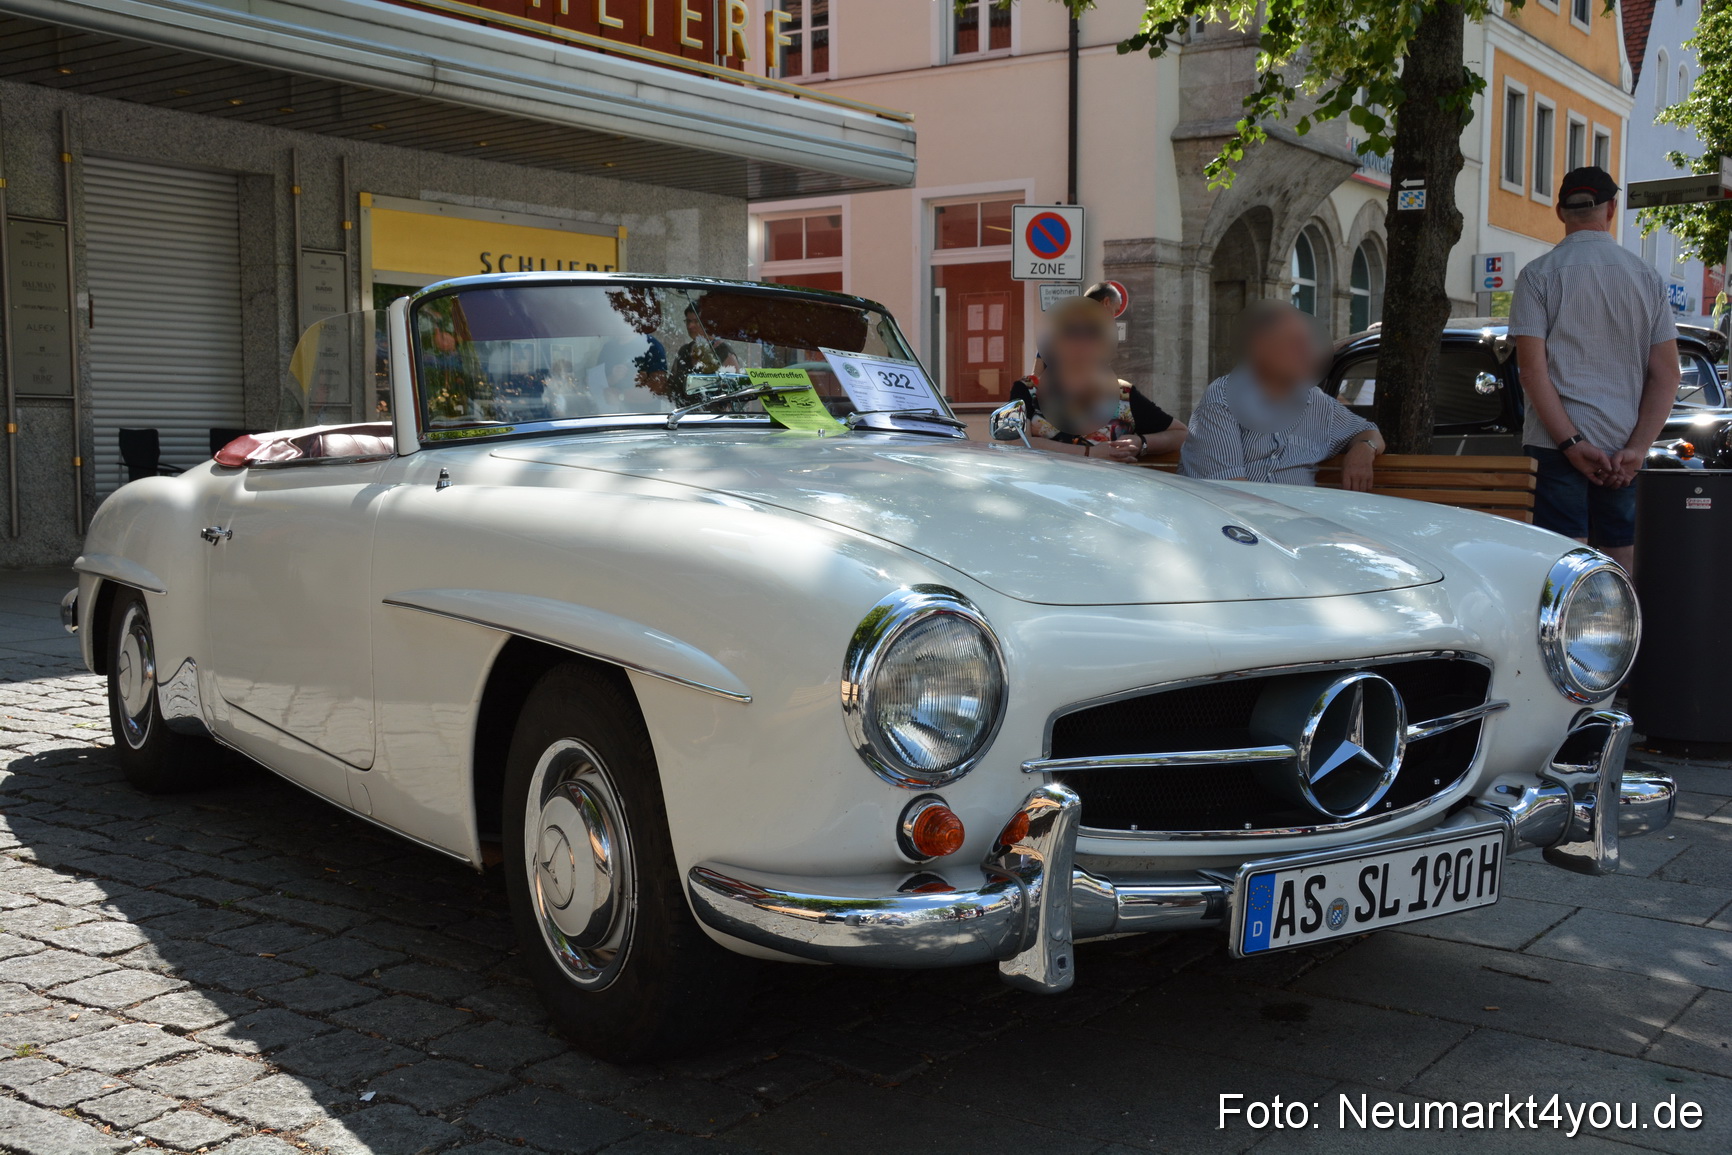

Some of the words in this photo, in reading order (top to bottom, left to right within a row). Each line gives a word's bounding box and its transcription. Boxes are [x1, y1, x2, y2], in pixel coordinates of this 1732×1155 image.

[20, 239, 54, 248] BREITLING
[21, 260, 56, 270] GUCCI
[1030, 263, 1066, 275] ZONE
[22, 280, 56, 290] BALMAIN
[26, 323, 56, 332] ALFEX
[750, 370, 804, 380] Oldtimertreffen
[877, 371, 915, 390] 322
[1252, 920, 1263, 938] D
[1272, 874, 1327, 940] AS
